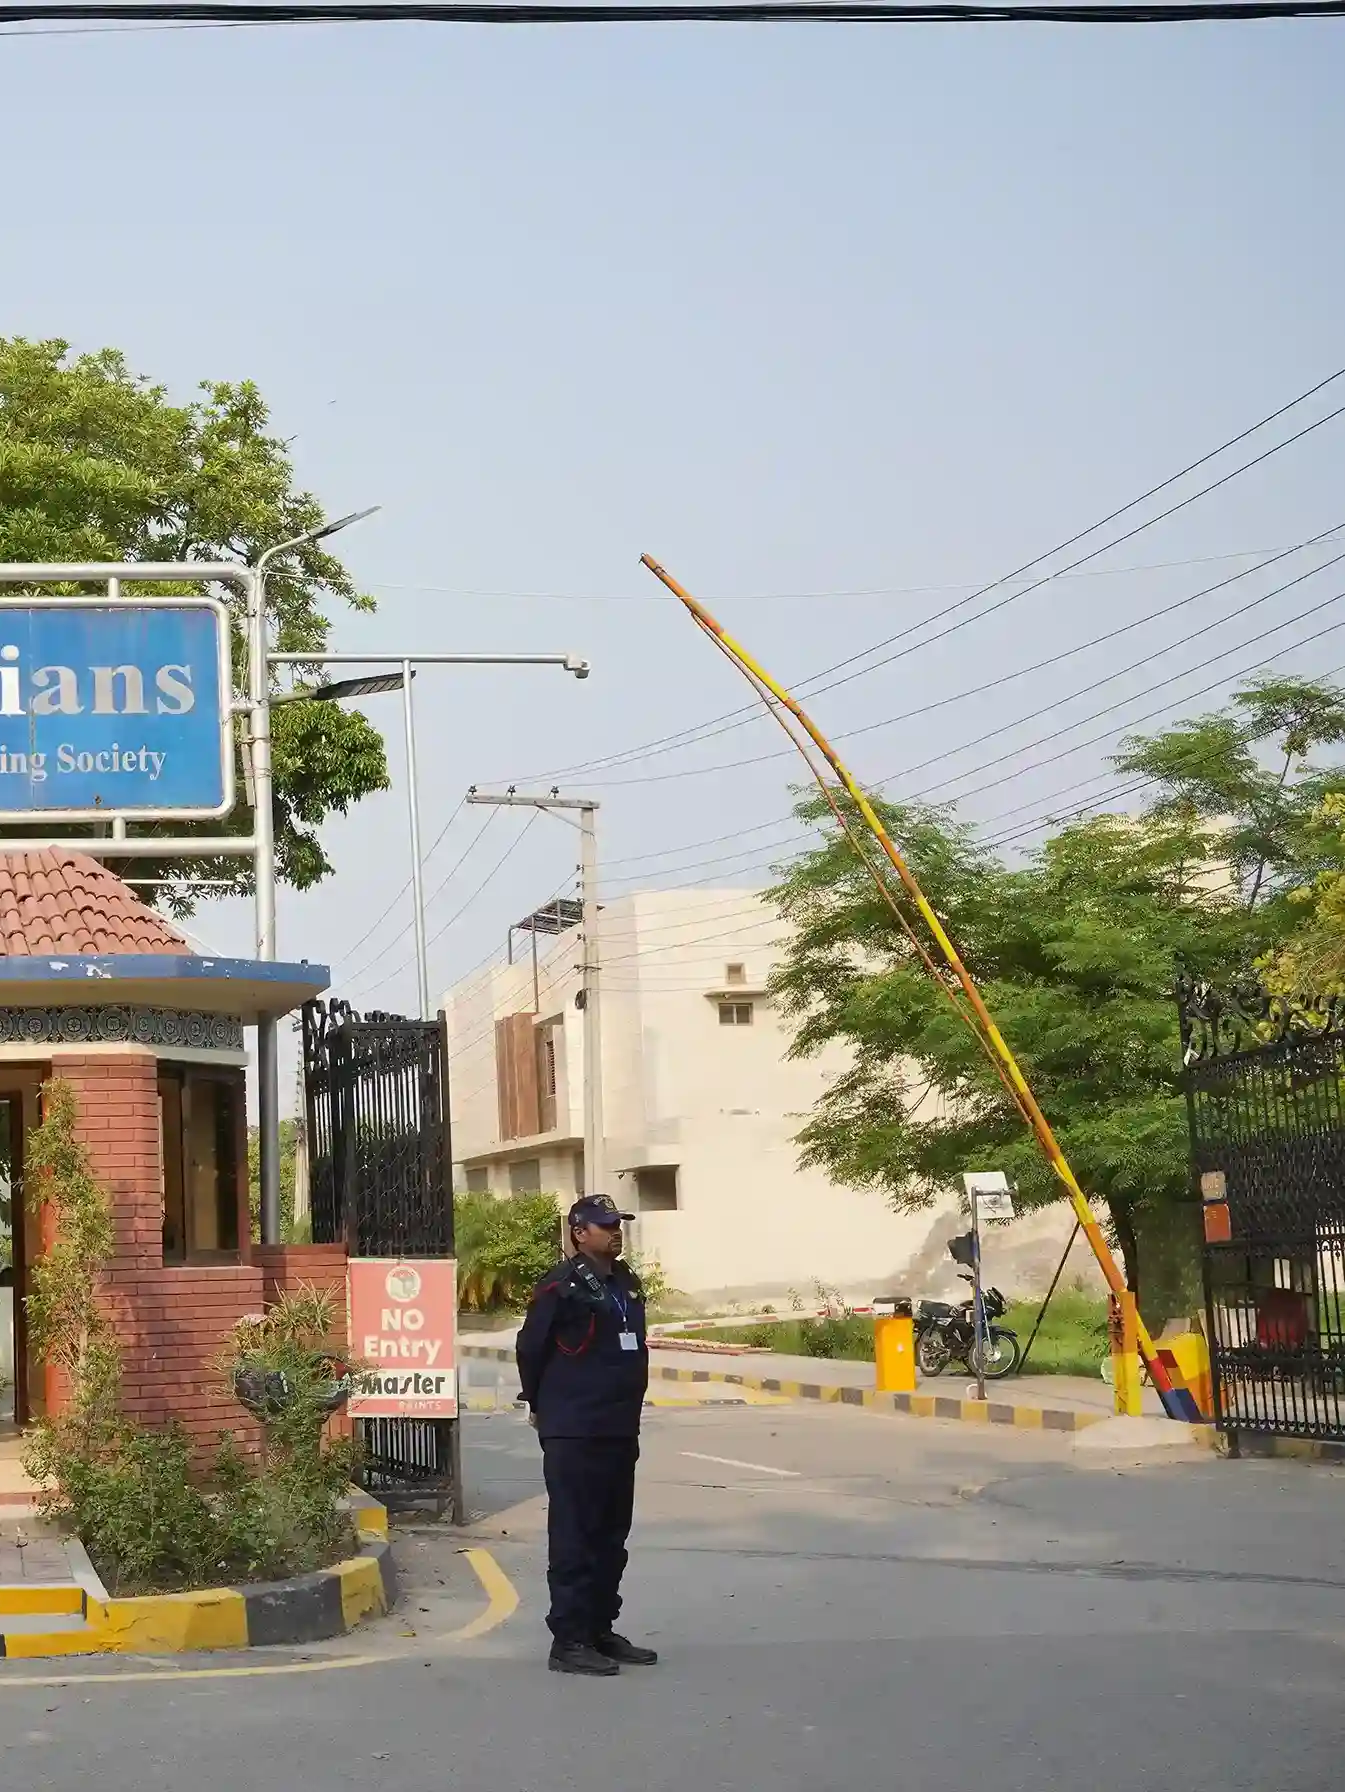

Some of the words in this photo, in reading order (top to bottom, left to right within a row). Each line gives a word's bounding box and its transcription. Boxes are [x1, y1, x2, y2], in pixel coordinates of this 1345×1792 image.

[56, 742, 166, 780] Society
[381, 1308, 424, 1331] NO
[364, 1335, 443, 1365] Entry
